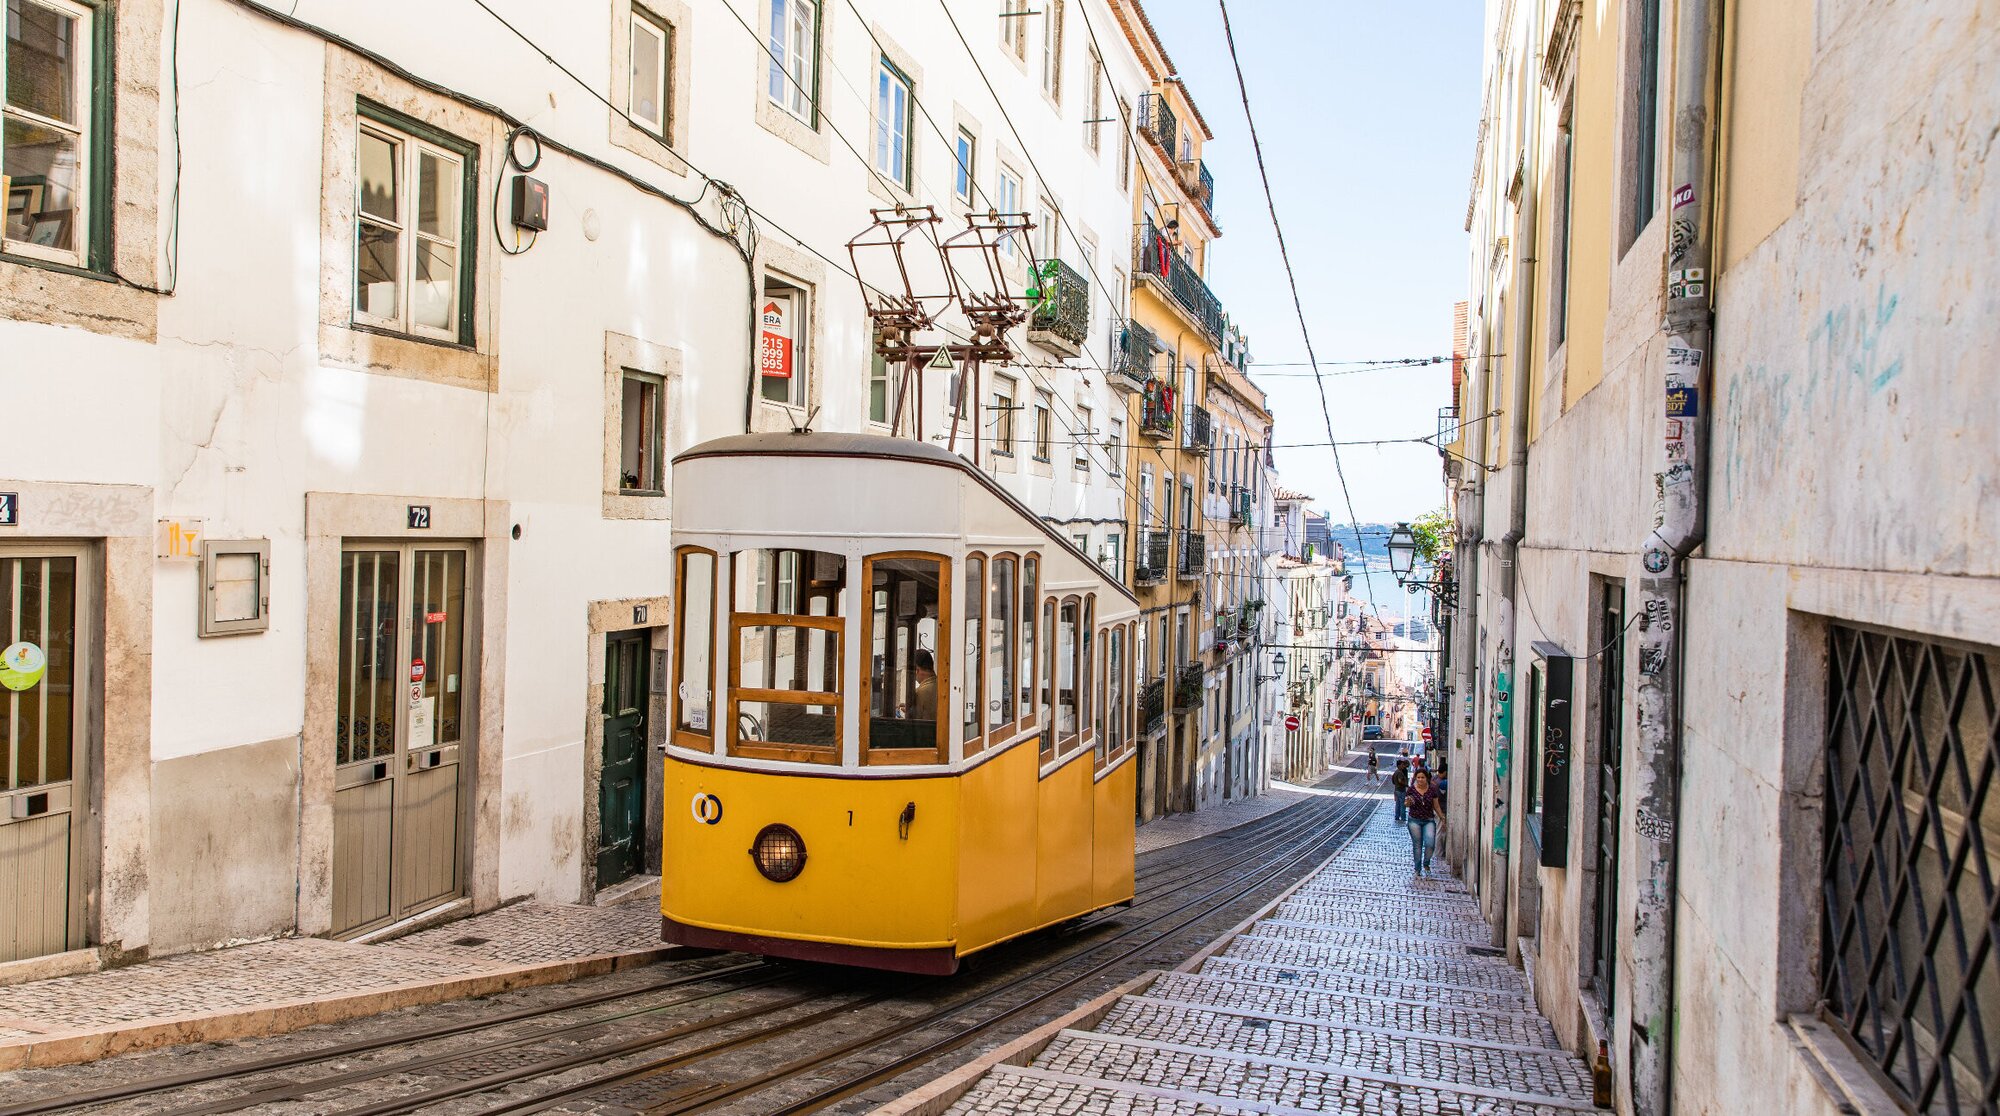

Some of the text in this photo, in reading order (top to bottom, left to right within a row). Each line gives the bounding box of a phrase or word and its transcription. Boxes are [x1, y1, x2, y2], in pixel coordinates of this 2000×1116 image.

[763, 315, 781, 325] ERA
[763, 337, 783, 349] 215
[762, 348, 783, 360] 999
[762, 358, 783, 370] 995
[412, 507, 428, 527] 72
[636, 606, 646, 623] 70
[847, 810, 854, 826] 1
